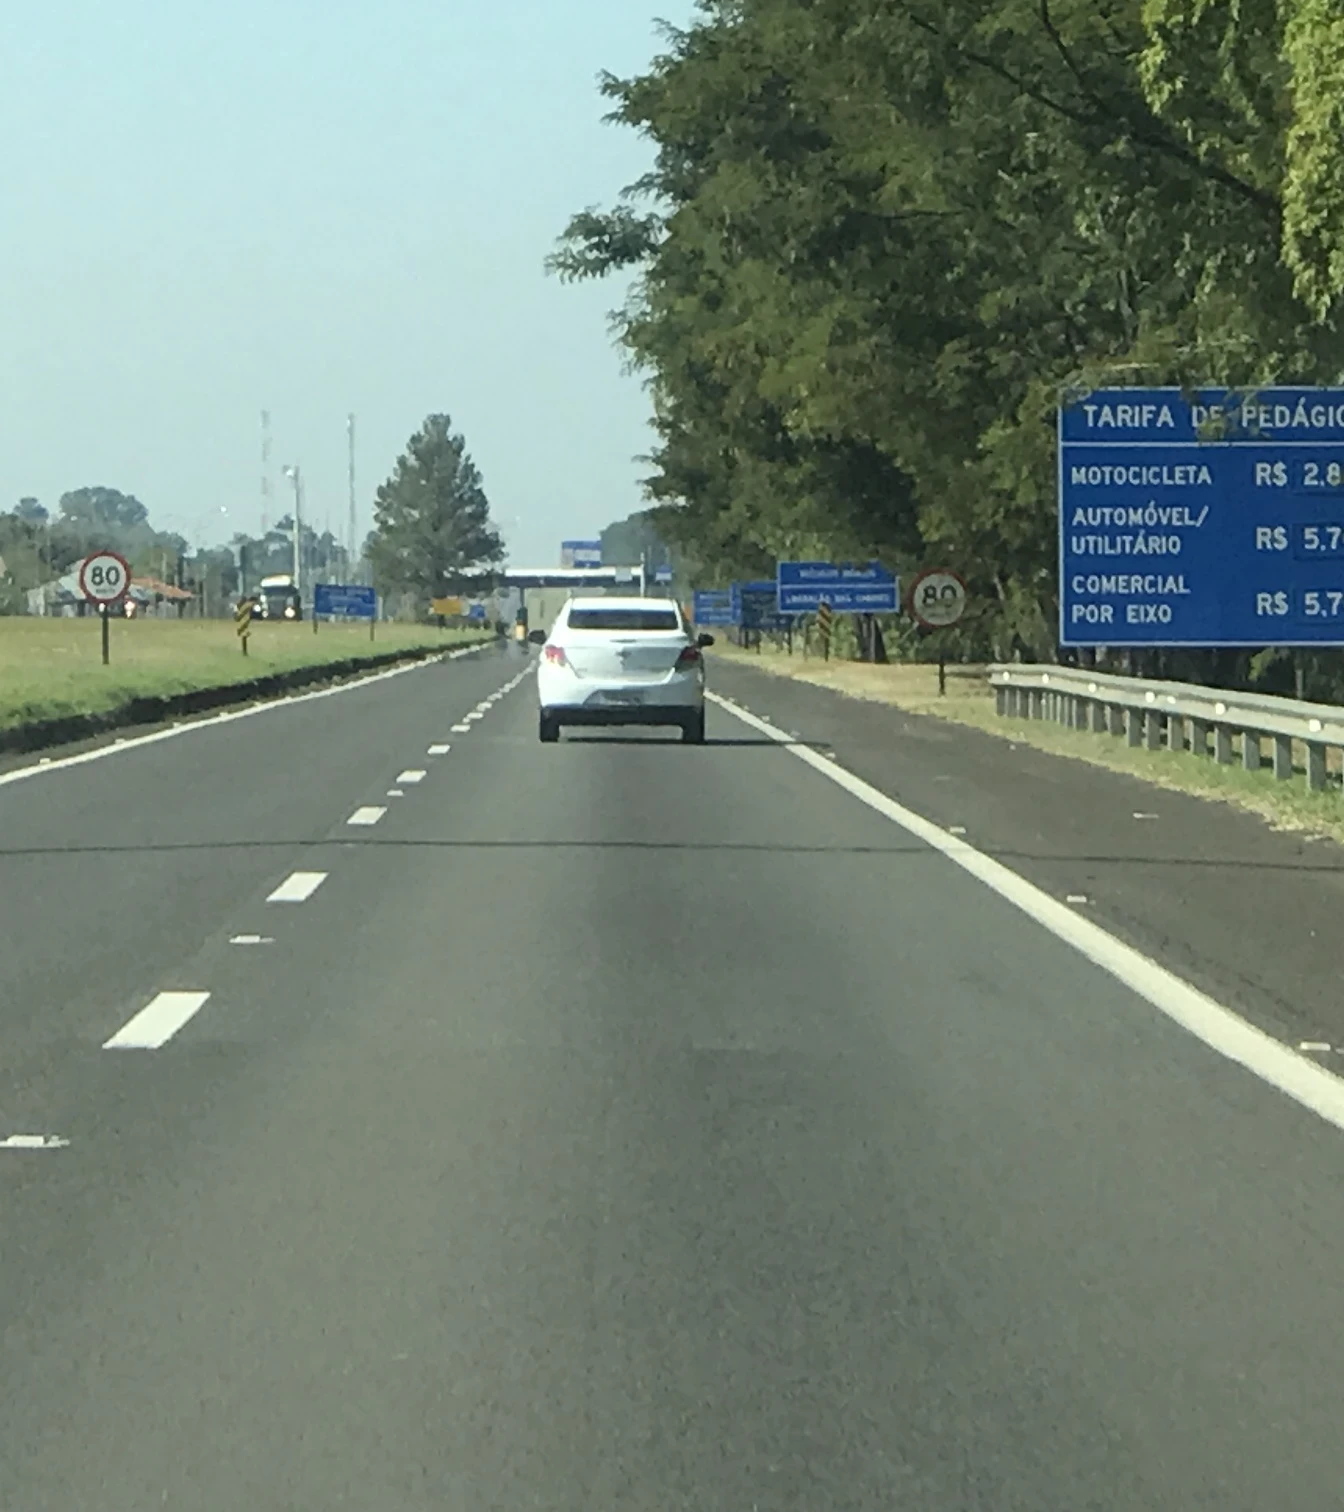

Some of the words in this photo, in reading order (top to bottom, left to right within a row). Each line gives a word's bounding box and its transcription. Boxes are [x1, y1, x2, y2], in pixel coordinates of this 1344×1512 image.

[1083, 404, 1175, 428] TARIFA
[1071, 465, 1212, 486] MOTOCICLETA
[1255, 461, 1288, 487] R$
[1071, 500, 1209, 528] AUTOMÓVEL/
[1071, 530, 1181, 555] UTILITÁRIO
[1256, 526, 1289, 551] R$
[91, 565, 120, 586] 80
[1071, 574, 1191, 595] COMERCIAL
[1071, 604, 1114, 624] POR
[1126, 604, 1172, 624] EIXO
[1256, 591, 1289, 616] R$
